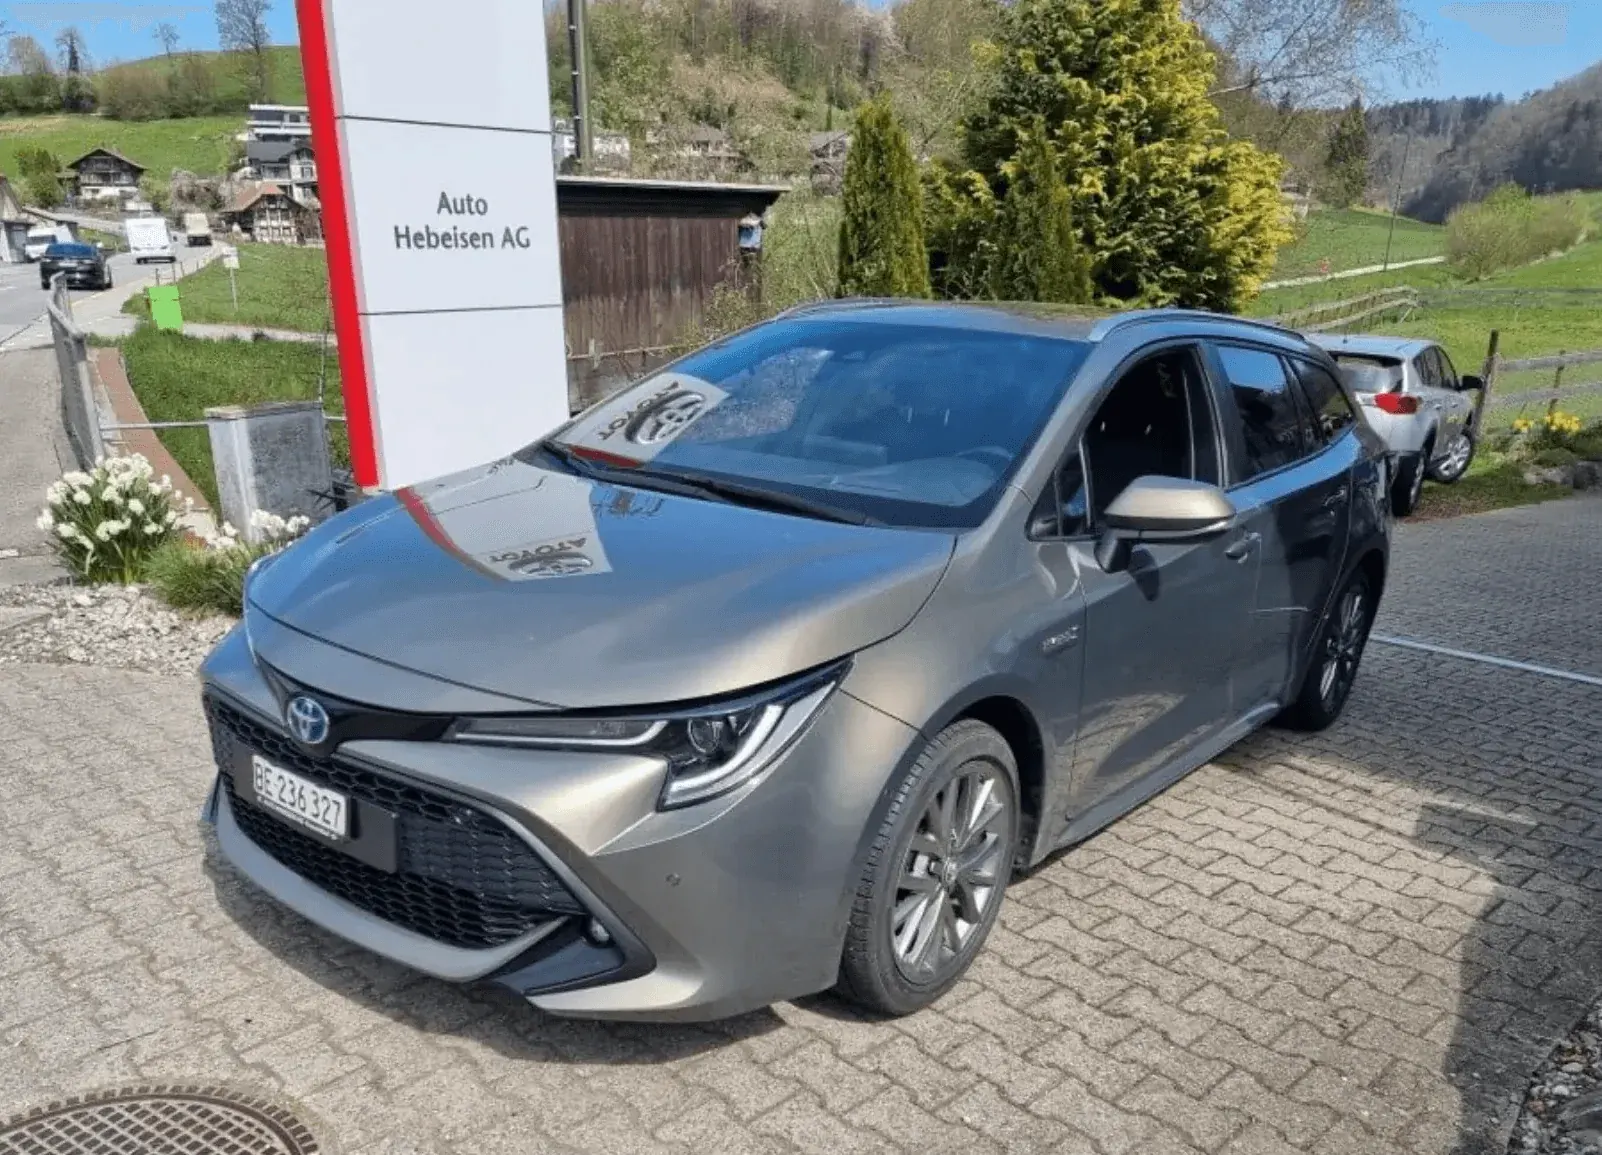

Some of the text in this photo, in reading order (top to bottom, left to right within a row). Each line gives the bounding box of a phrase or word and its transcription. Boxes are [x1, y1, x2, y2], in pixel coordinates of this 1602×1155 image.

[436, 190, 489, 216] Auto
[394, 224, 531, 249] Hebeisen AG
